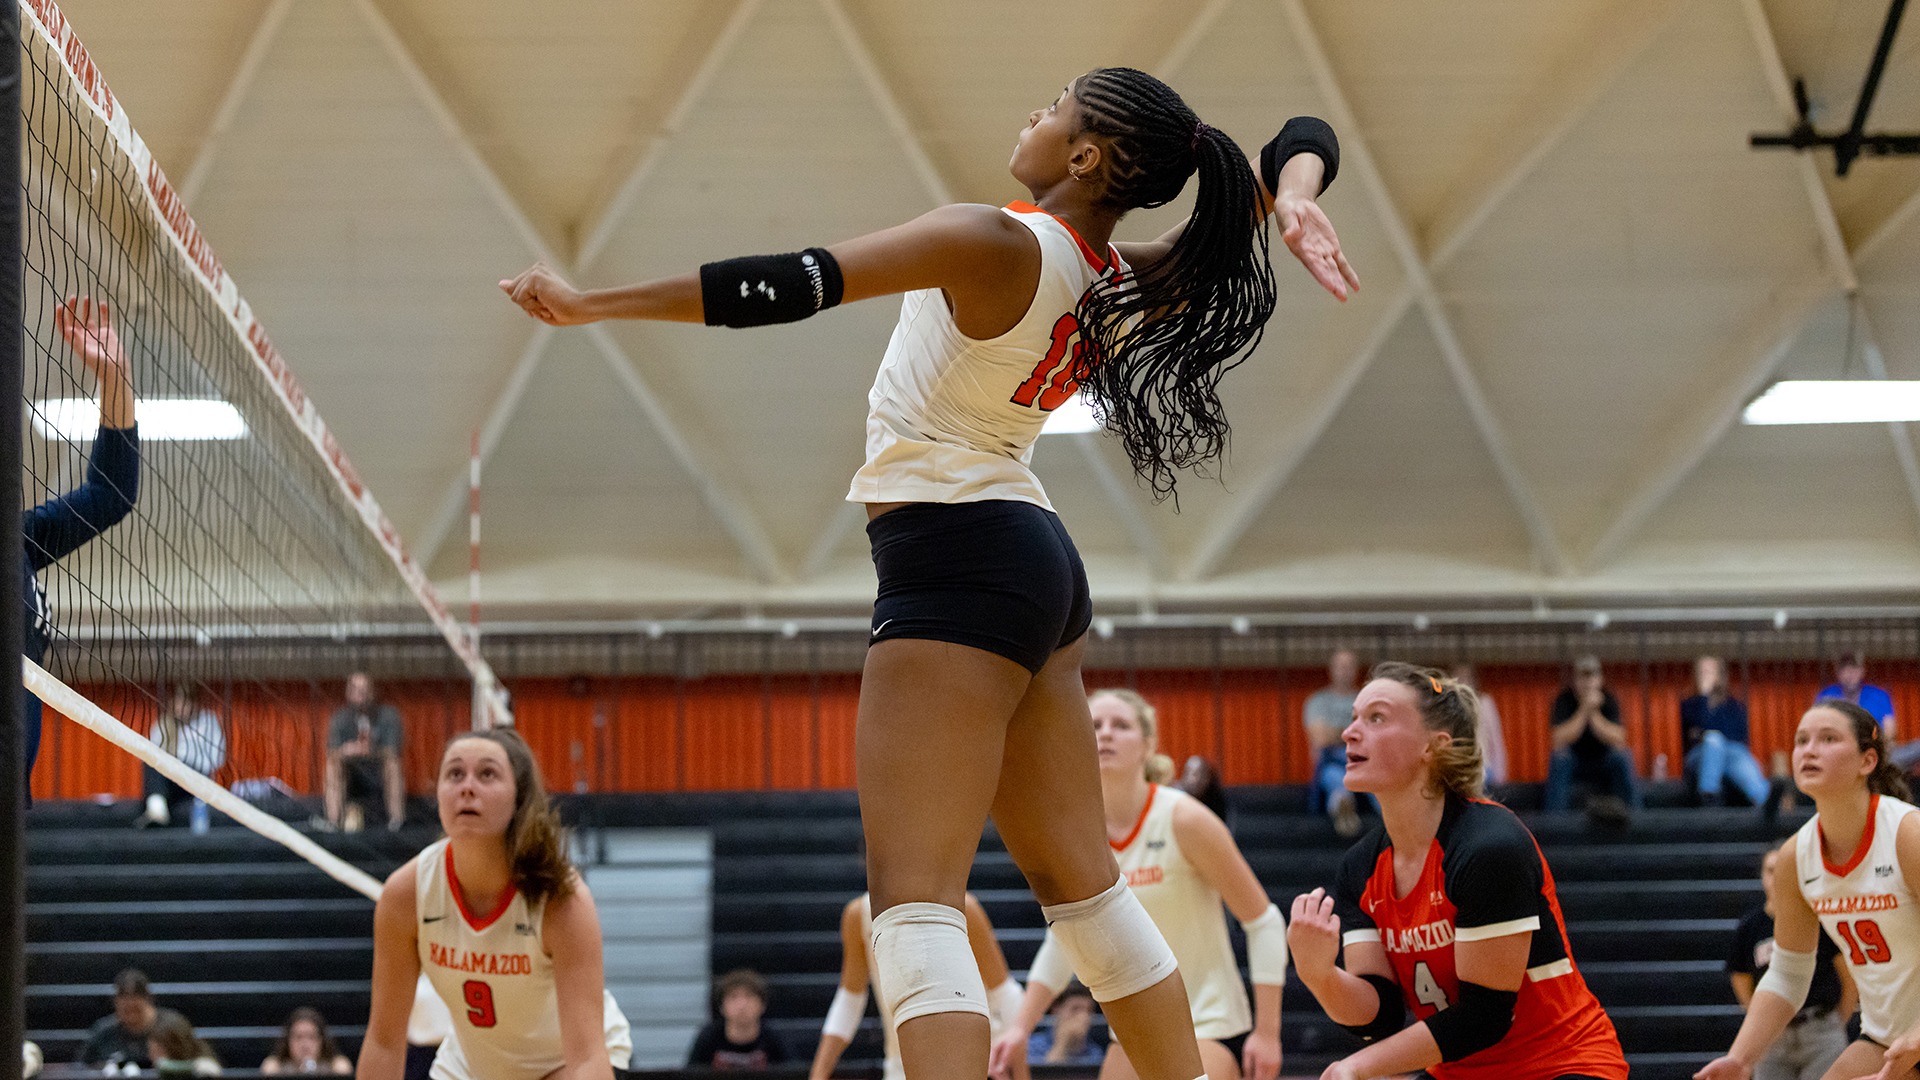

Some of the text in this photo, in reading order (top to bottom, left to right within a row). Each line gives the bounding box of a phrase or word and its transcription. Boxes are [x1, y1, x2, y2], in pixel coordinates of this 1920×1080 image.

[430, 943, 532, 976] KALAMAZOO
[1837, 919, 1892, 966] 19
[463, 979, 497, 1028] 9
[1414, 961, 1450, 1013] 4
